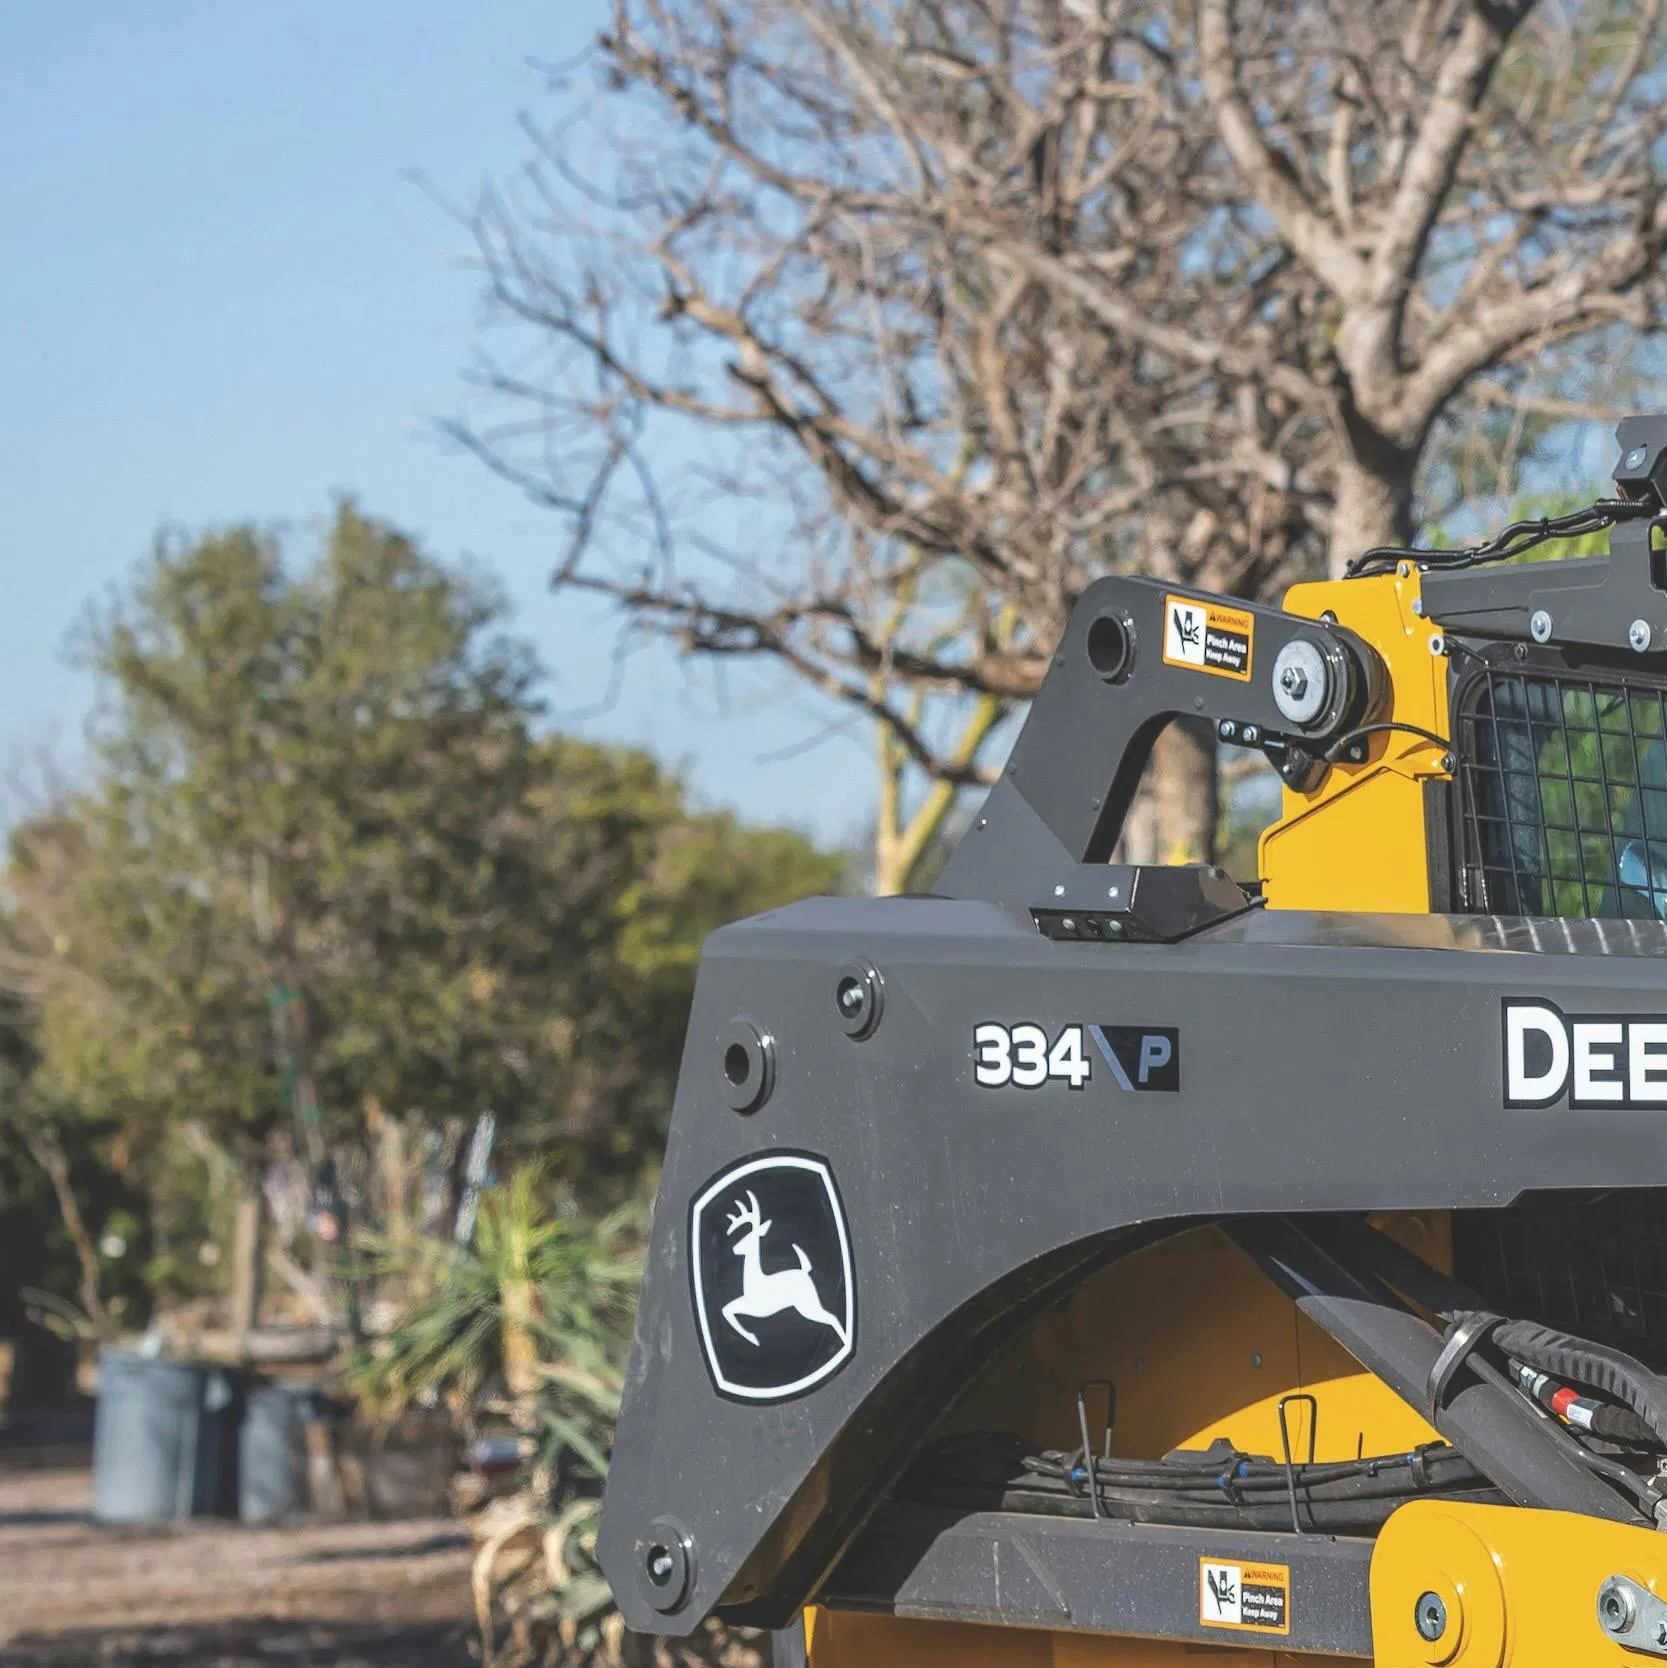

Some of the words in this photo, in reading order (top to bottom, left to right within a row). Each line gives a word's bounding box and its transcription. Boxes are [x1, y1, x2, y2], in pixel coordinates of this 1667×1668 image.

[1206, 633, 1228, 649] Pinch
[1229, 640, 1247, 653] Area
[1205, 649, 1223, 663] Keep
[1223, 652, 1240, 667] Away
[975, 1022, 1091, 1090] 334
[1250, 1570, 1284, 1582] WARNING
[1243, 1591, 1264, 1604] Pinch
[1265, 1594, 1283, 1606] Area
[1242, 1606, 1260, 1618] Keep
[1259, 1608, 1279, 1621] Away
